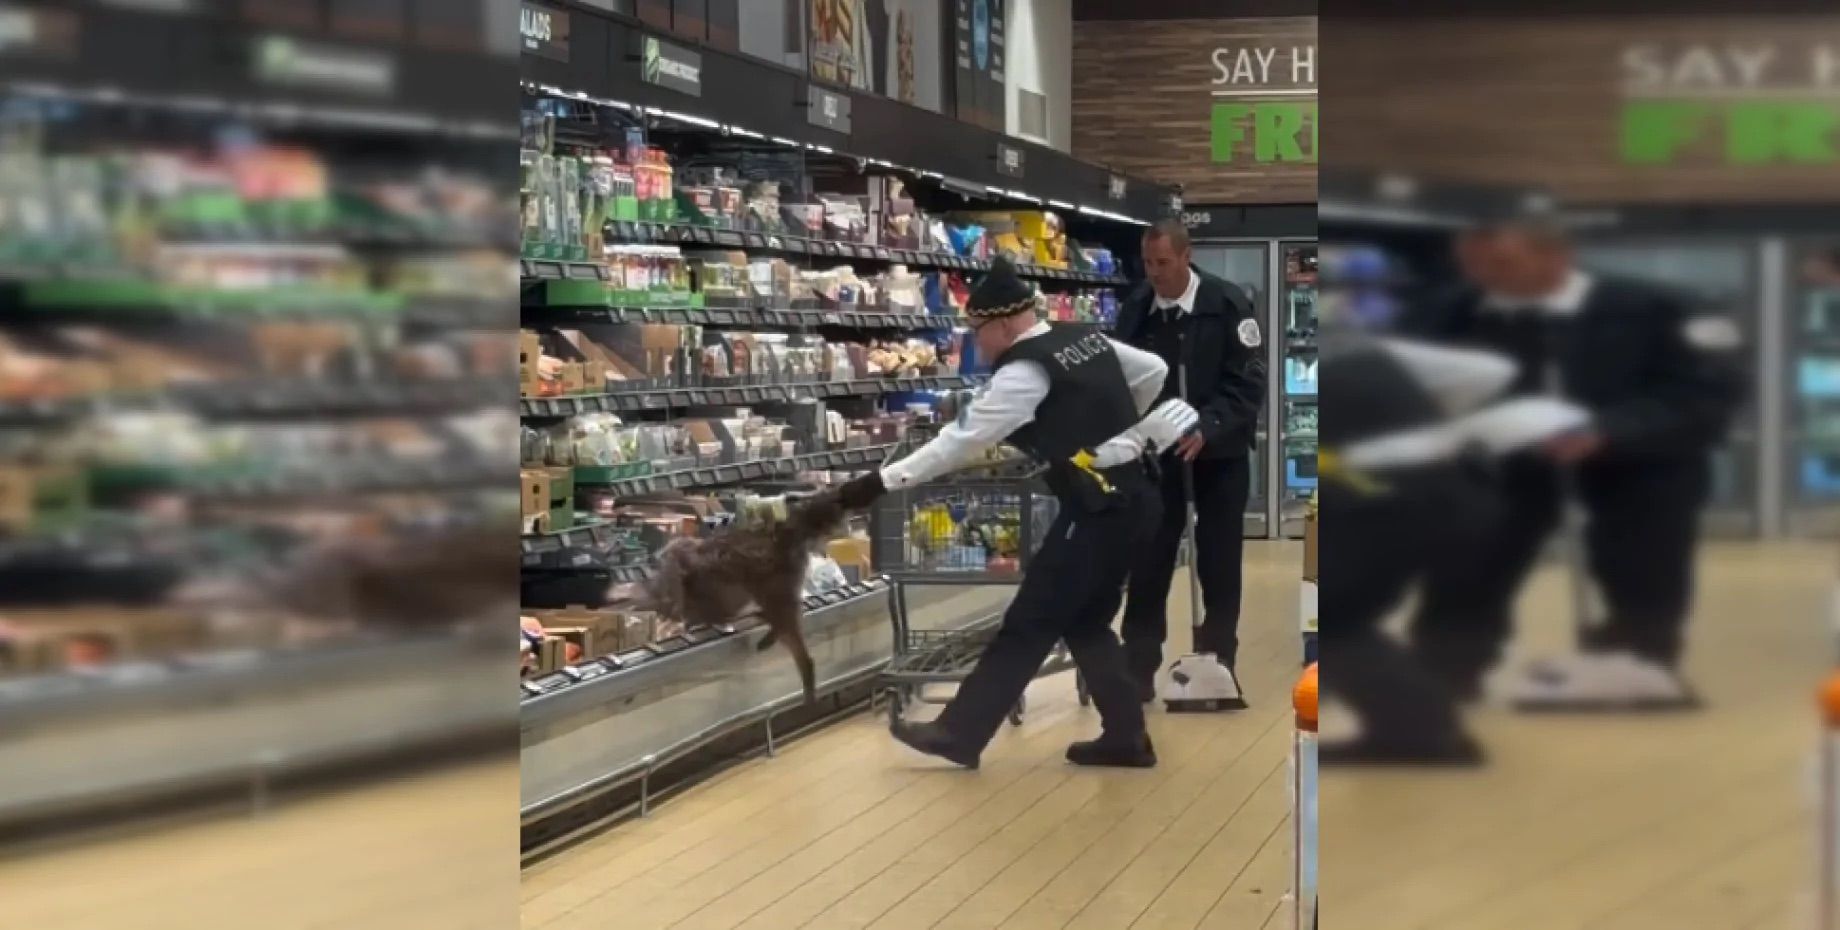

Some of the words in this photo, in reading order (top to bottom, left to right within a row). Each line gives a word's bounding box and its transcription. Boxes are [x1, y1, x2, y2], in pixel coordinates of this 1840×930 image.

[1211, 47, 1275, 84] SAY
[1291, 45, 1315, 83] H
[1210, 102, 1318, 163] FR
[1053, 333, 1108, 371] POLICE
